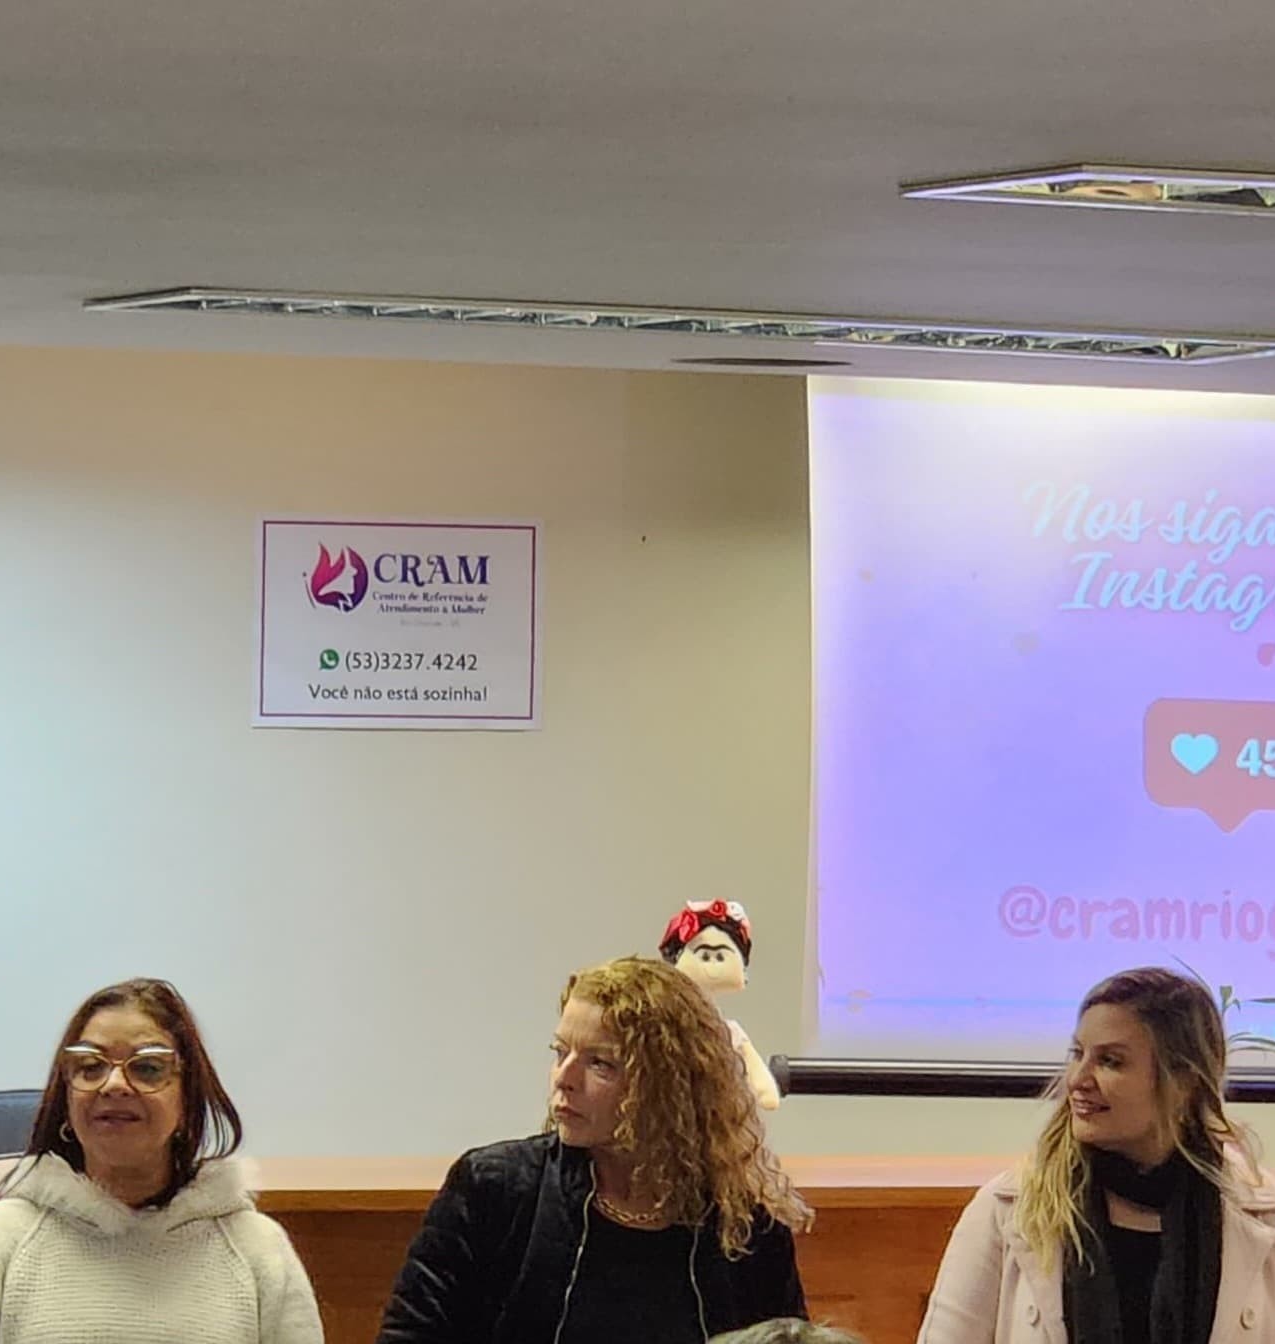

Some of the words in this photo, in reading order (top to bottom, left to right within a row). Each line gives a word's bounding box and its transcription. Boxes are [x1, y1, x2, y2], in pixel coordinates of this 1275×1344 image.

[1023, 480, 1152, 545] Nos
[373, 553, 490, 587] CRAM
[372, 592, 406, 601] Centro
[408, 592, 419, 601] de
[477, 593, 488, 603] de
[451, 605, 486, 615] Mulher
[345, 650, 478, 672] (53)3237.4242
[308, 683, 349, 699] Você
[353, 686, 382, 700] não
[386, 686, 418, 700] está
[423, 685, 487, 701] sozinha!
